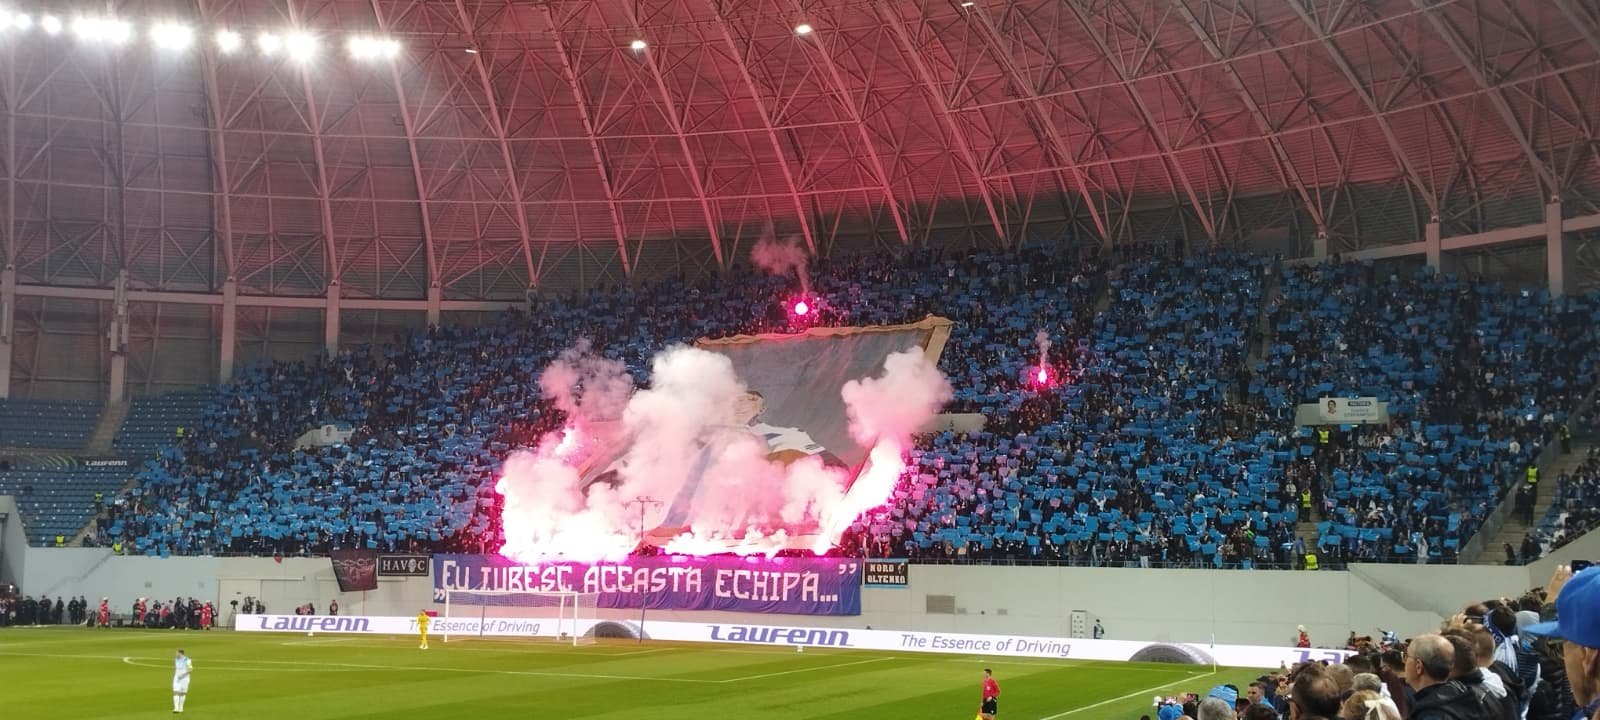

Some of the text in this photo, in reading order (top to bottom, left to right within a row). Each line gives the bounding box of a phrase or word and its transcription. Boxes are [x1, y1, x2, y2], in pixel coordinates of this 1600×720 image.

[382, 558, 425, 573] HAVOC
[870, 564, 895, 573] NORD
[480, 565, 572, 592] IUBESC
[433, 619, 479, 632] Essence
[482, 620, 496, 632] of
[497, 621, 541, 635] Driving
[901, 634, 1071, 657] The Essence of Driving
